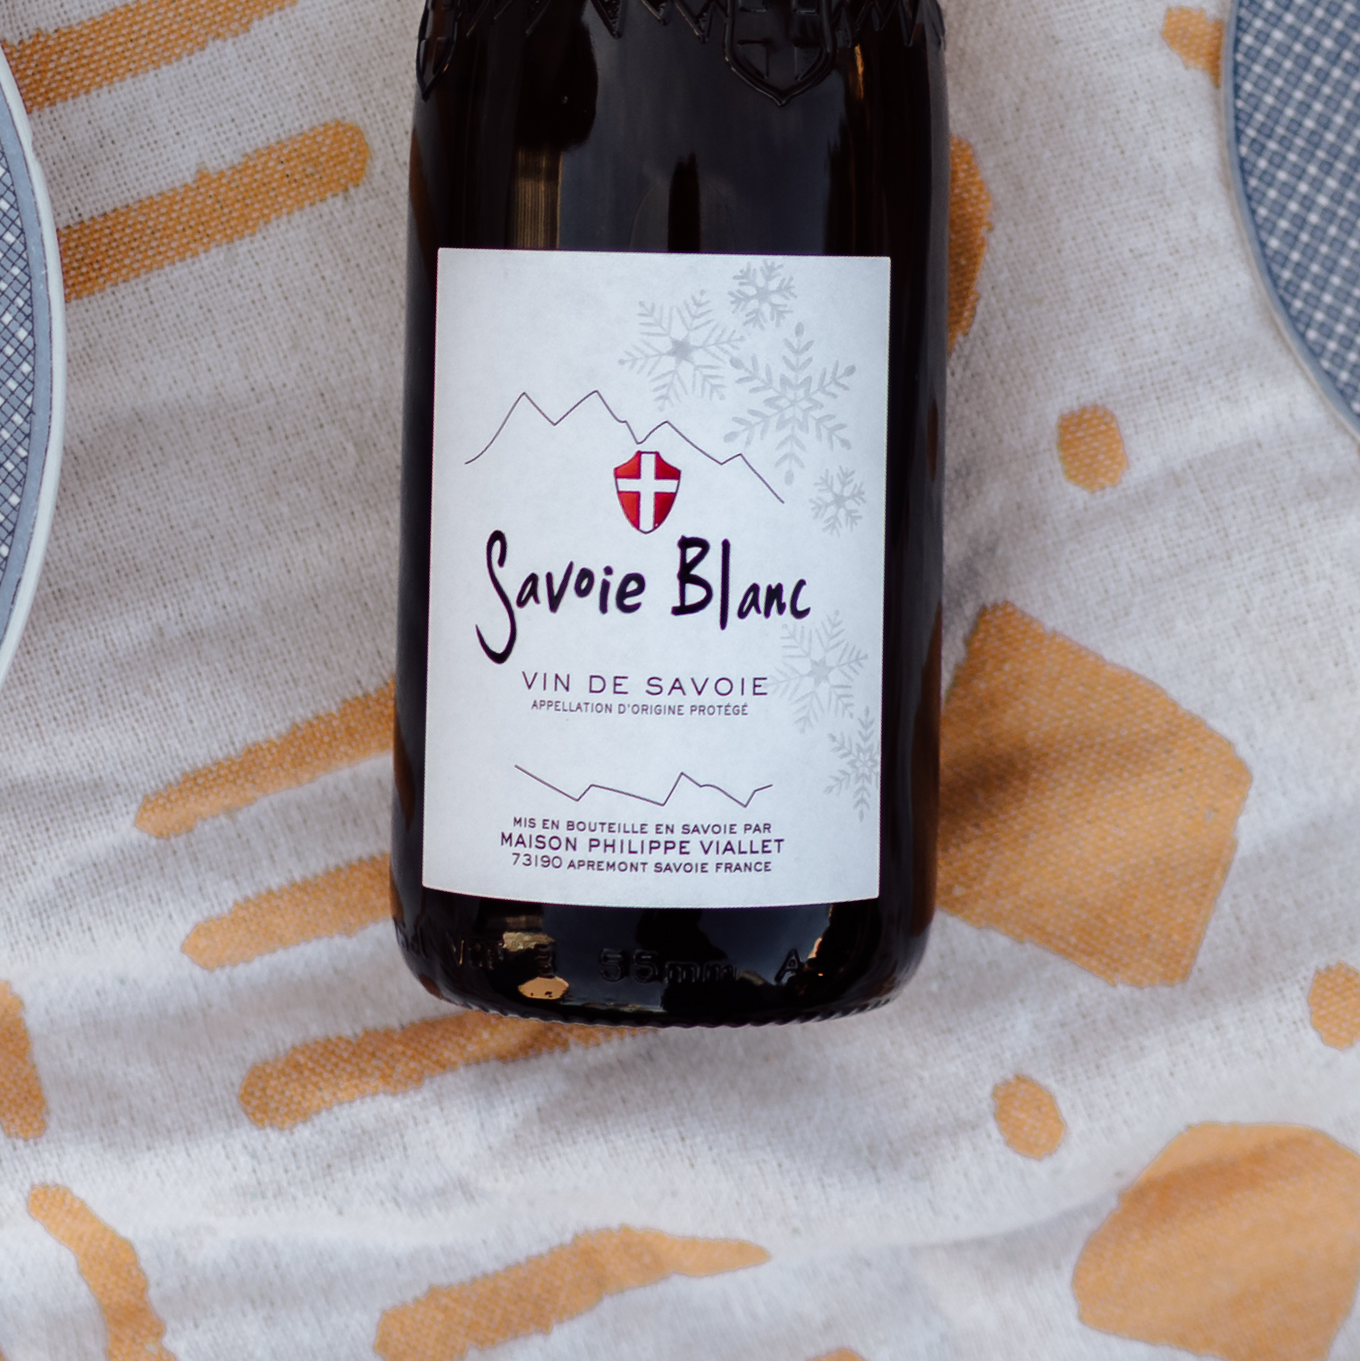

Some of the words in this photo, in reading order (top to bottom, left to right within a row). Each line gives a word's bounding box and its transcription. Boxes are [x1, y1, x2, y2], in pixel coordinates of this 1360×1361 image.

[475, 529, 646, 665] Savoie
[670, 535, 811, 630] Blanc
[522, 671, 571, 692] VIN
[588, 674, 629, 695] DE
[645, 676, 768, 697] SAVOIE
[531, 699, 613, 715] APPELLATION
[617, 703, 685, 716] D'ORIGINE
[690, 702, 749, 716] PROTÉGÉ
[513, 816, 537, 829] MIS
[542, 818, 560, 830] EN
[566, 820, 649, 835] BOUTEILLE
[655, 823, 675, 835] EN
[681, 823, 737, 835] SAVOIE
[743, 823, 772, 834] PAR
[500, 831, 578, 852] MAISON
[588, 838, 691, 855] PHILIPPE
[699, 838, 785, 855] VIALLET
[511, 852, 563, 869] 73190
[567, 859, 649, 873] APREMONT
[653, 862, 709, 873] SAVOIE
[715, 861, 772, 873] FRANCE
